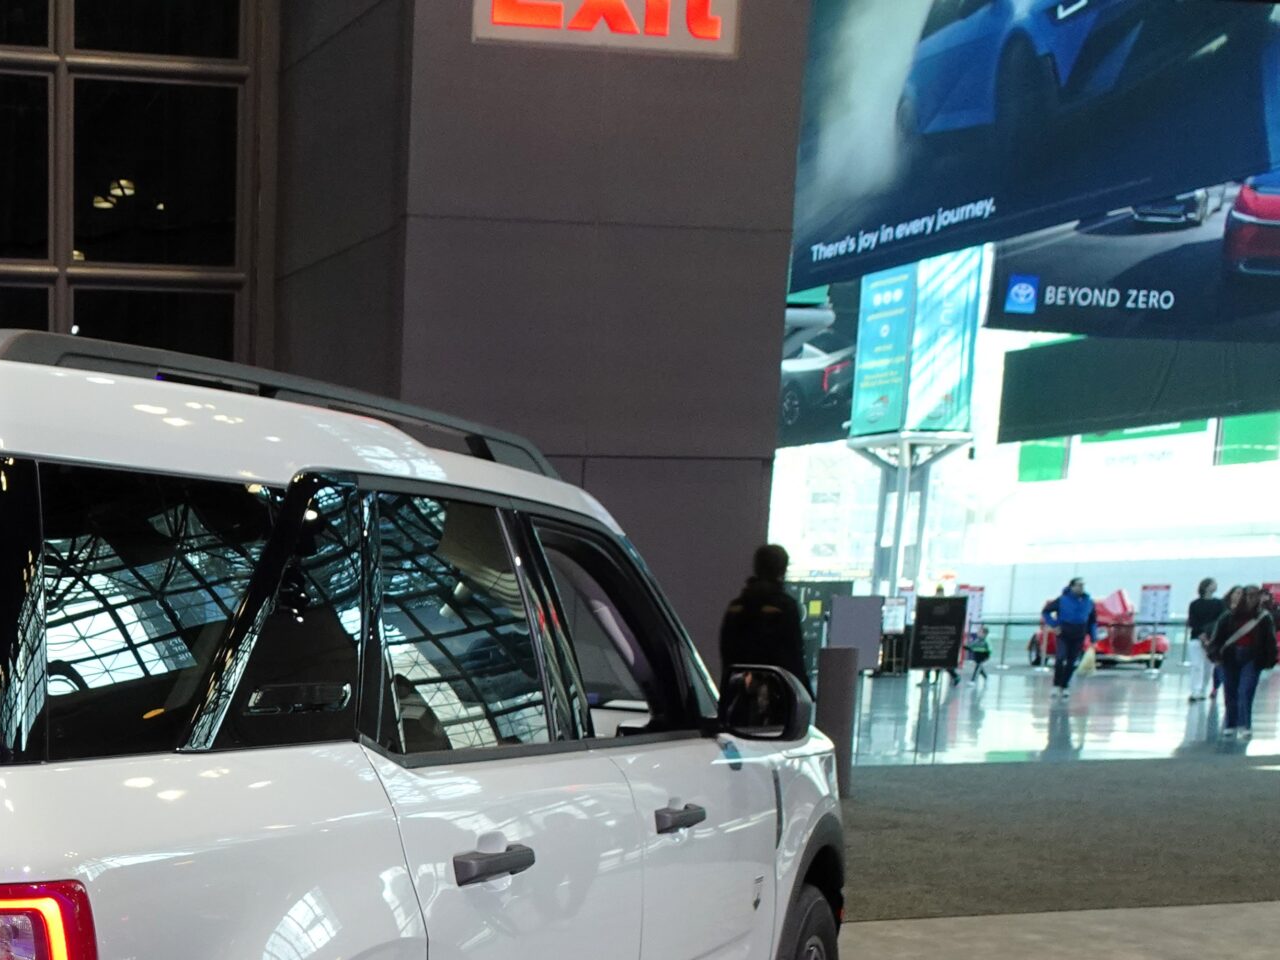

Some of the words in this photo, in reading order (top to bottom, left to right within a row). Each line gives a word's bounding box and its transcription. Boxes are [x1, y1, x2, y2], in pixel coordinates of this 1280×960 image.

[810, 233, 855, 262] There's
[857, 229, 879, 253] joy
[879, 224, 894, 244] in
[895, 213, 935, 240] every
[935, 197, 996, 232] journey.
[1043, 285, 1121, 308] BEYOND
[1125, 289, 1175, 310] ZERO
